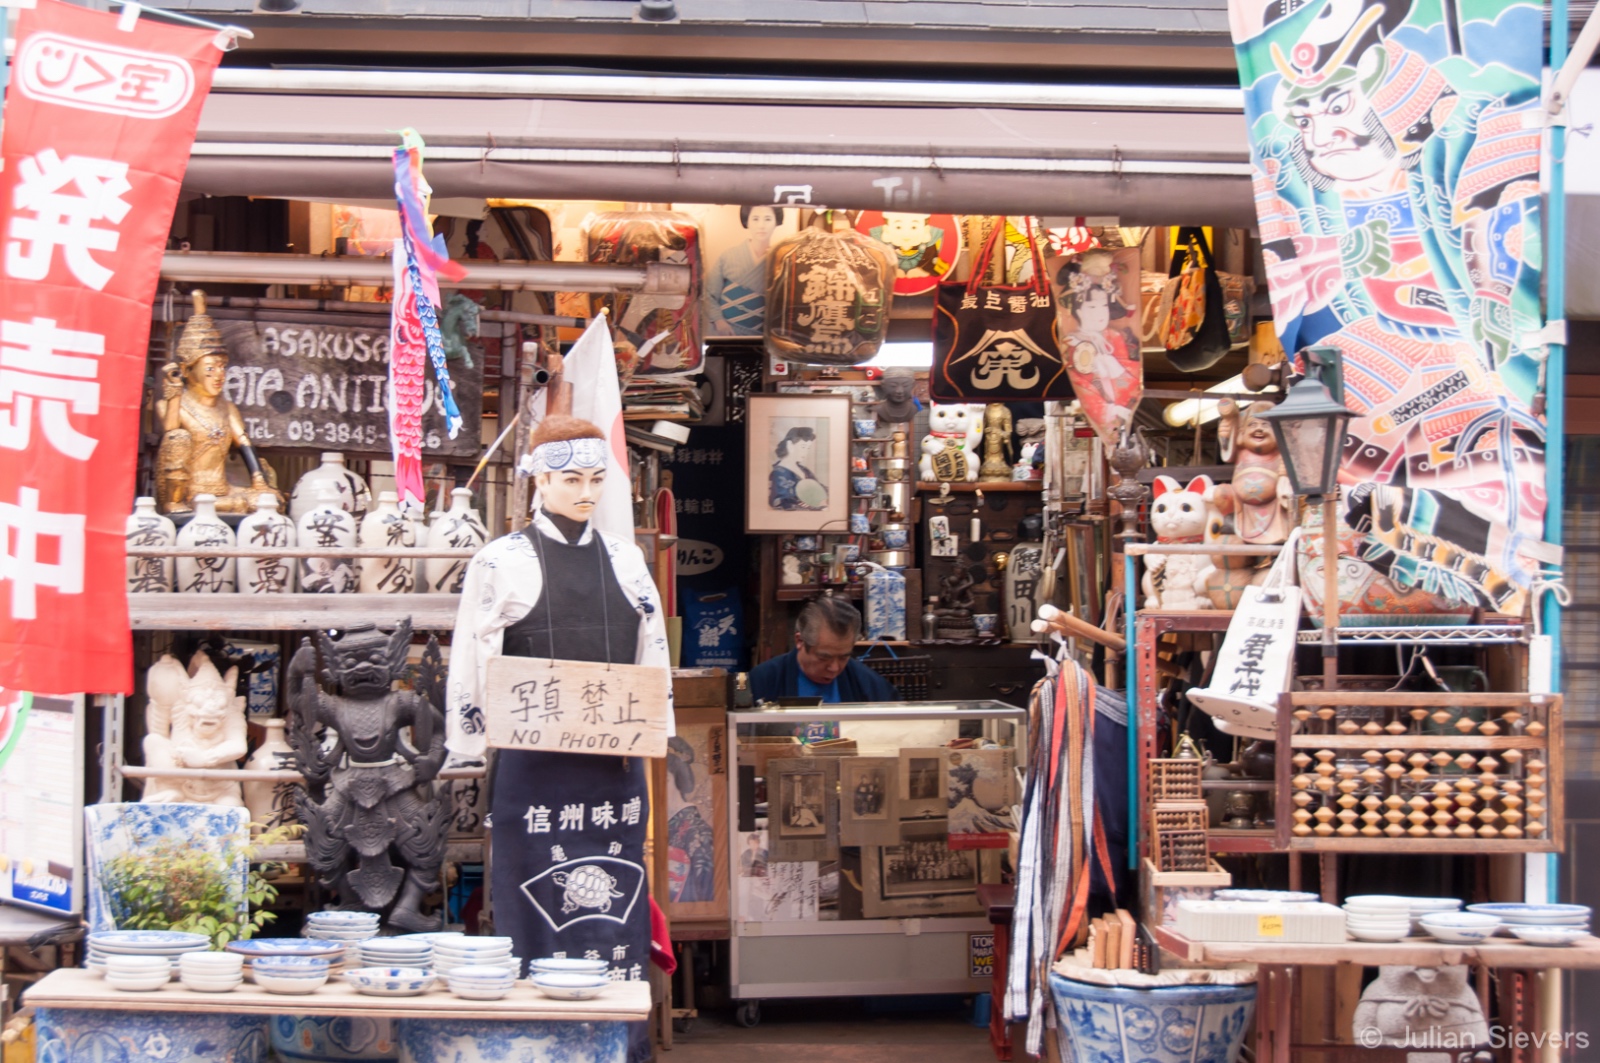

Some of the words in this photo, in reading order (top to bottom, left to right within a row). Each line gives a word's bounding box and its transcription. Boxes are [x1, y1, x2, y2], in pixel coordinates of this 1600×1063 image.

[510, 729, 541, 745] NO
[523, 796, 642, 834] 信州味噌
[973, 937, 995, 947] TOK
[974, 956, 994, 966] WE
[973, 965, 993, 975] 20
